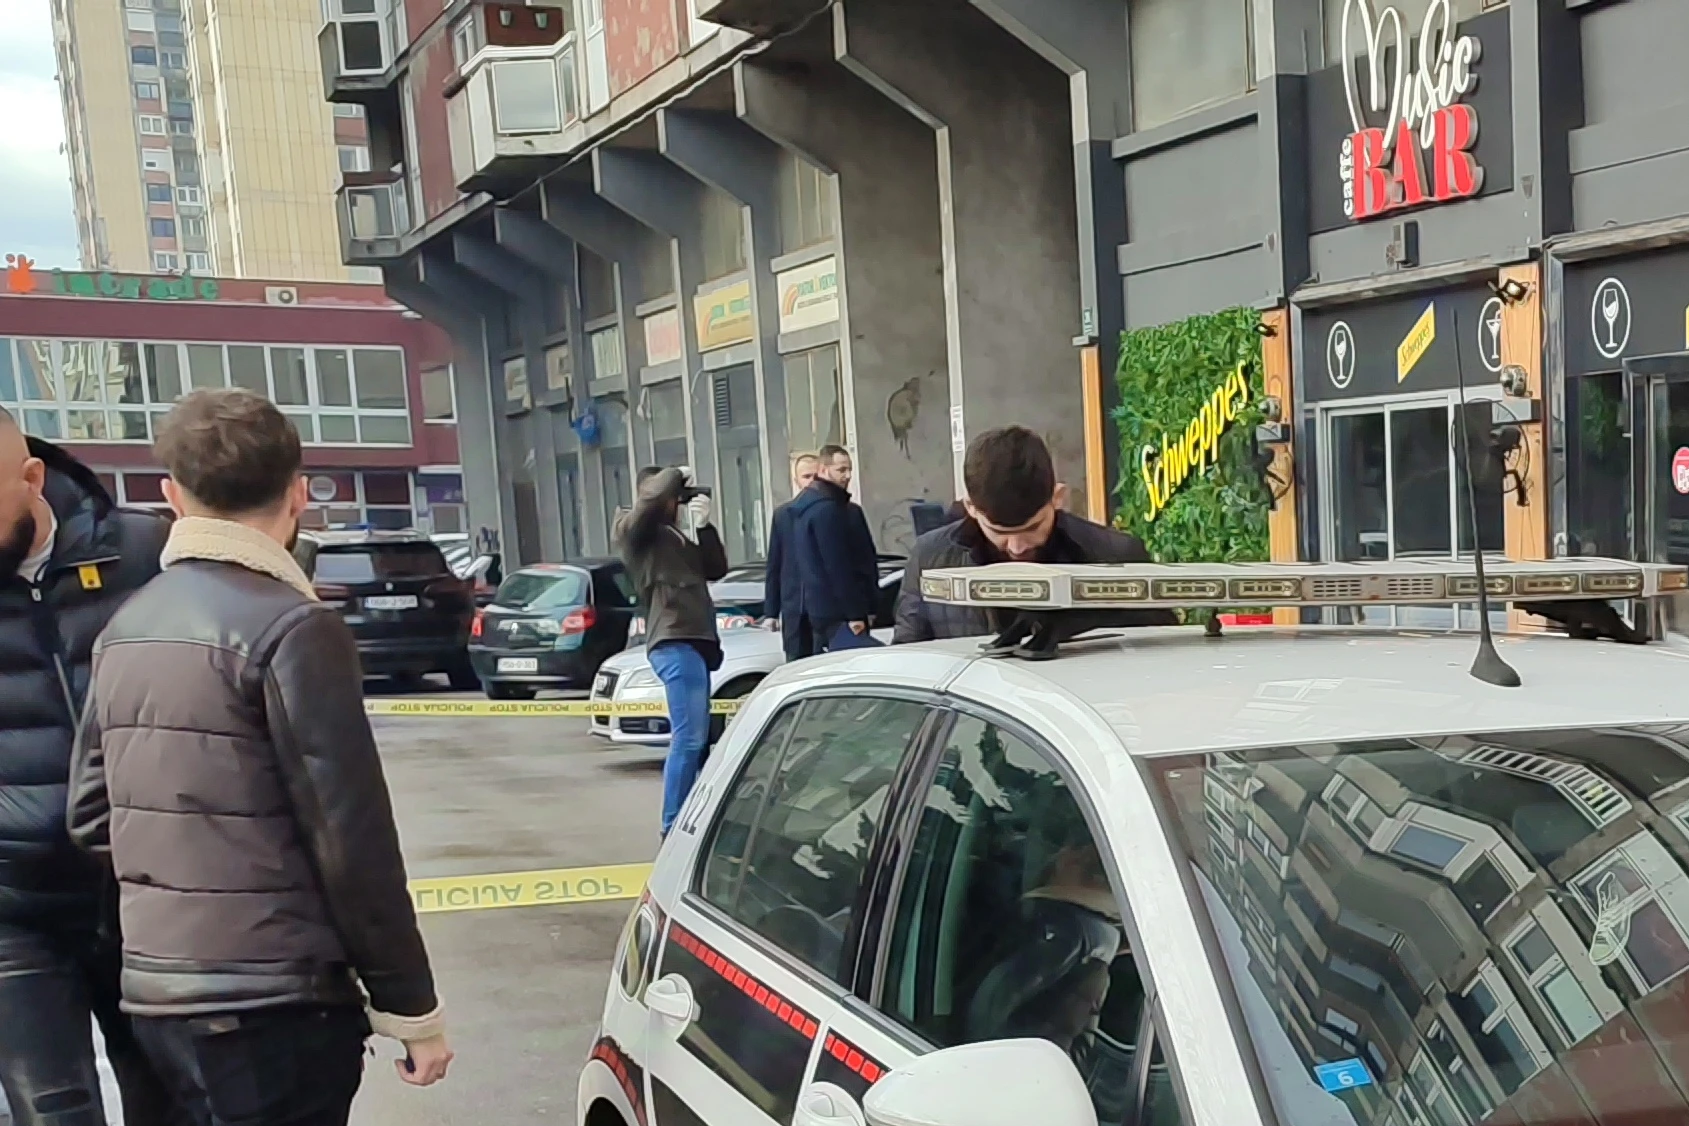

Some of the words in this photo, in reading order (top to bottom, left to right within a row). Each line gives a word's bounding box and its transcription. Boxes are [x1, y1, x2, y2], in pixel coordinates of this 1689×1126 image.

[1342, 0, 1473, 149] Music
[1351, 104, 1478, 219] BAR
[1402, 321, 1430, 367] Schweppes
[1141, 359, 1248, 523] Schweppes
[390, 703, 421, 712] STOP
[424, 703, 474, 712] POLICIJA
[489, 702, 519, 712] STOP
[520, 702, 569, 712] POLICIJA
[585, 702, 613, 712] STOP
[615, 702, 663, 712] POLICIJA
